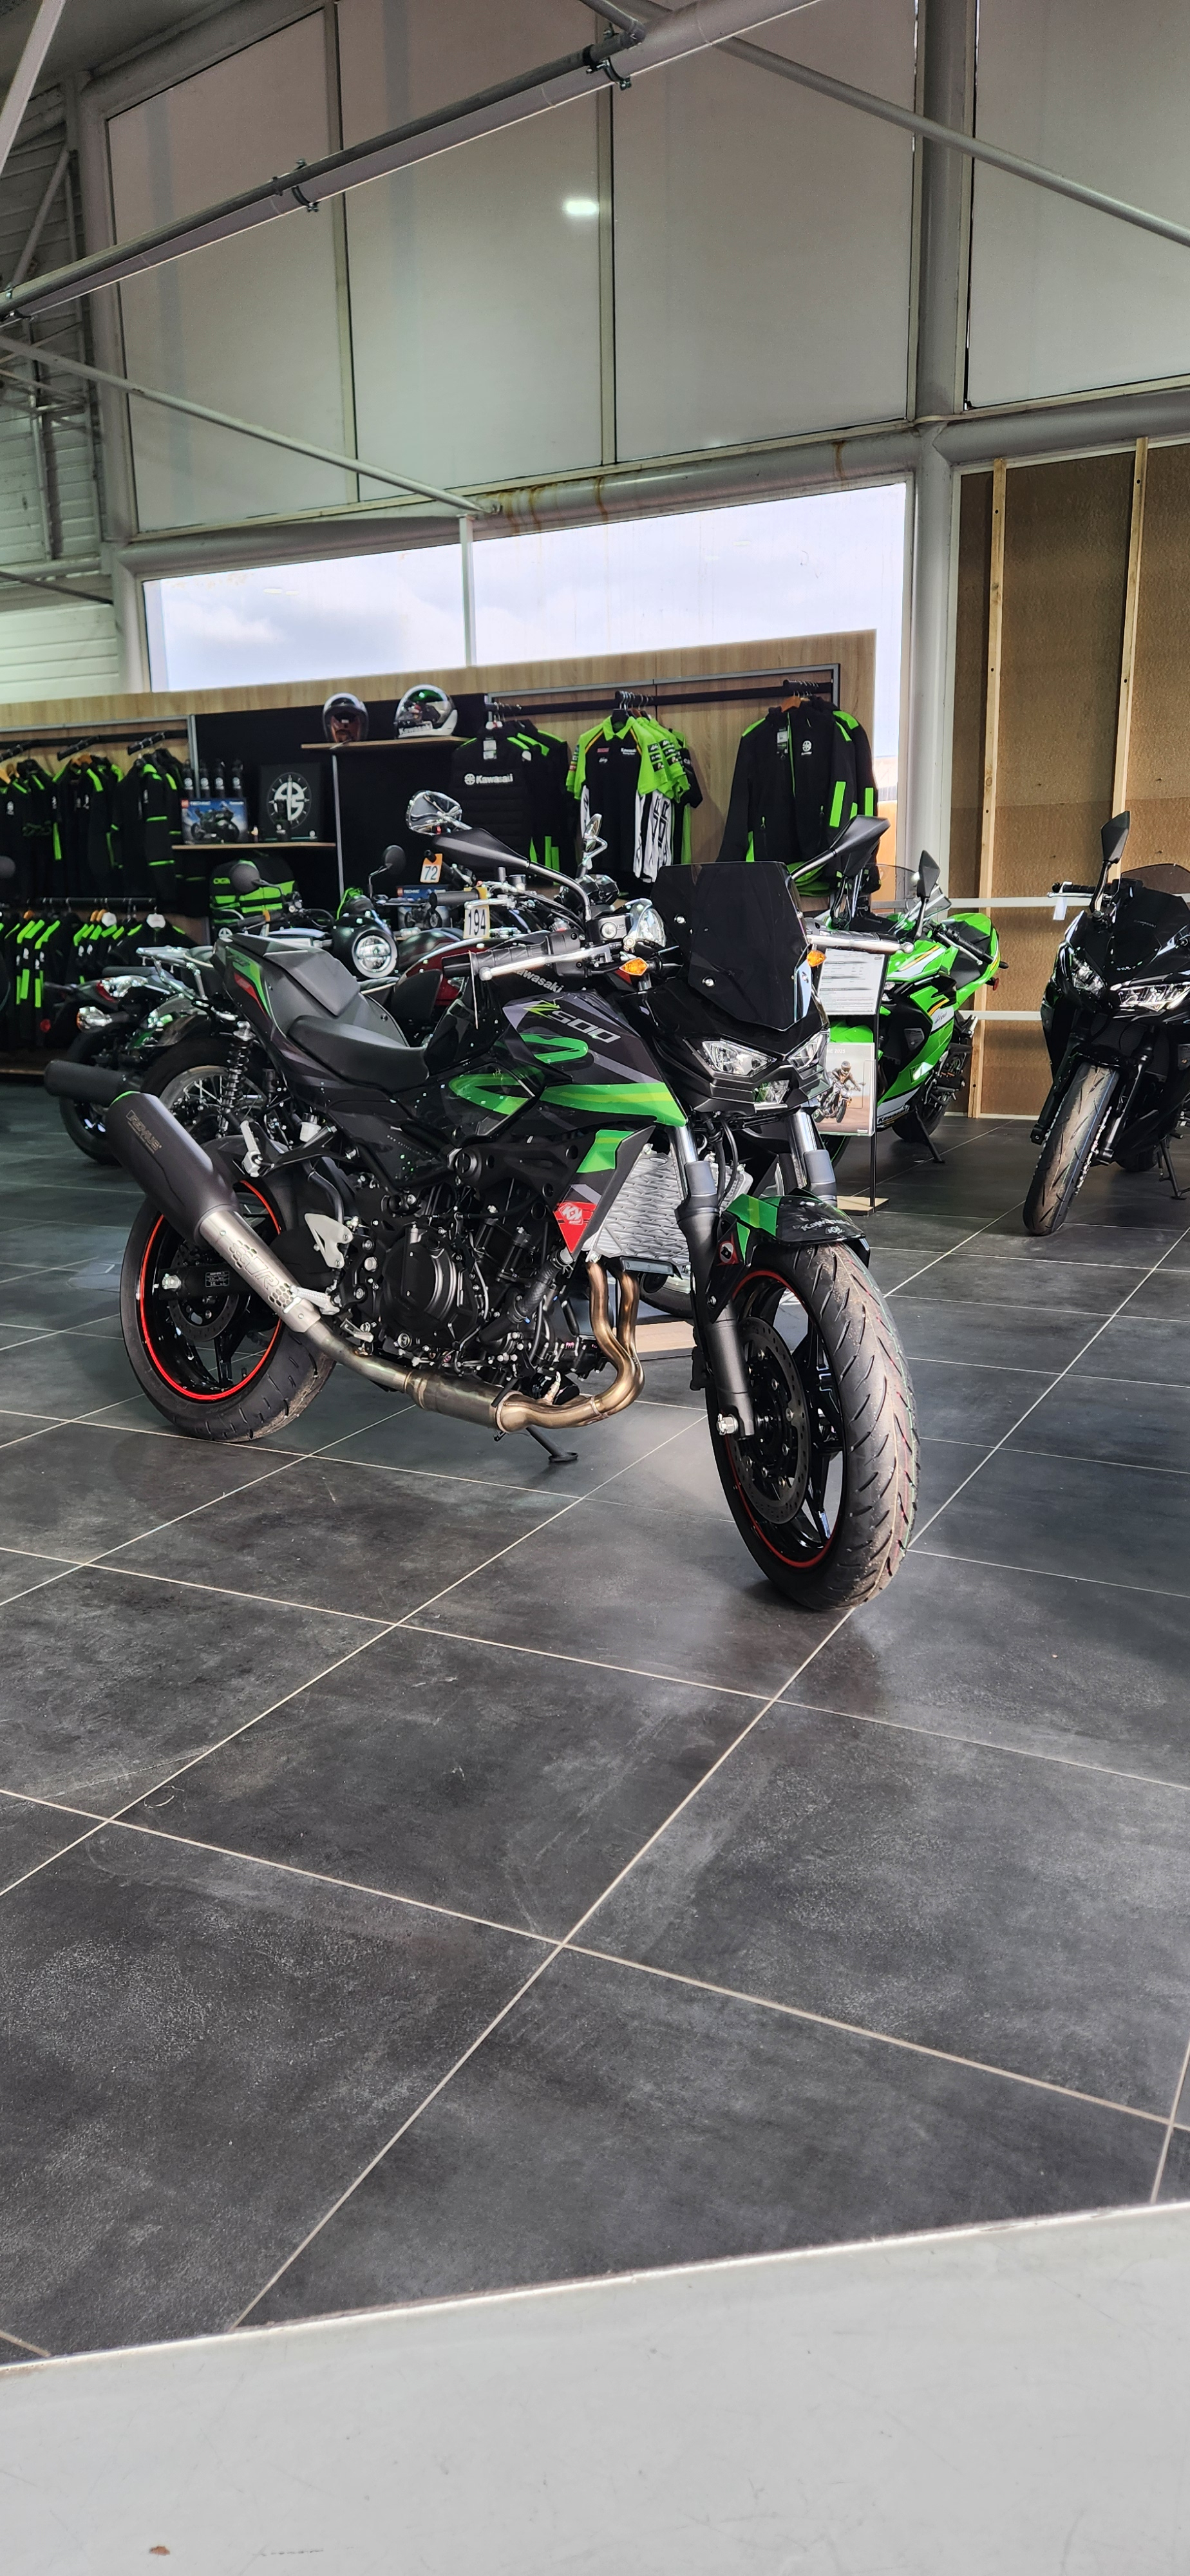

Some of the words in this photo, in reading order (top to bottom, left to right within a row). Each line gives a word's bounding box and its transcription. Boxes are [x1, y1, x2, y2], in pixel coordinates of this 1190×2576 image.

[476, 773, 513, 784] Kawasaki
[424, 866, 439, 880] 72
[468, 909, 486, 936] 194
[515, 969, 565, 993] awasaki
